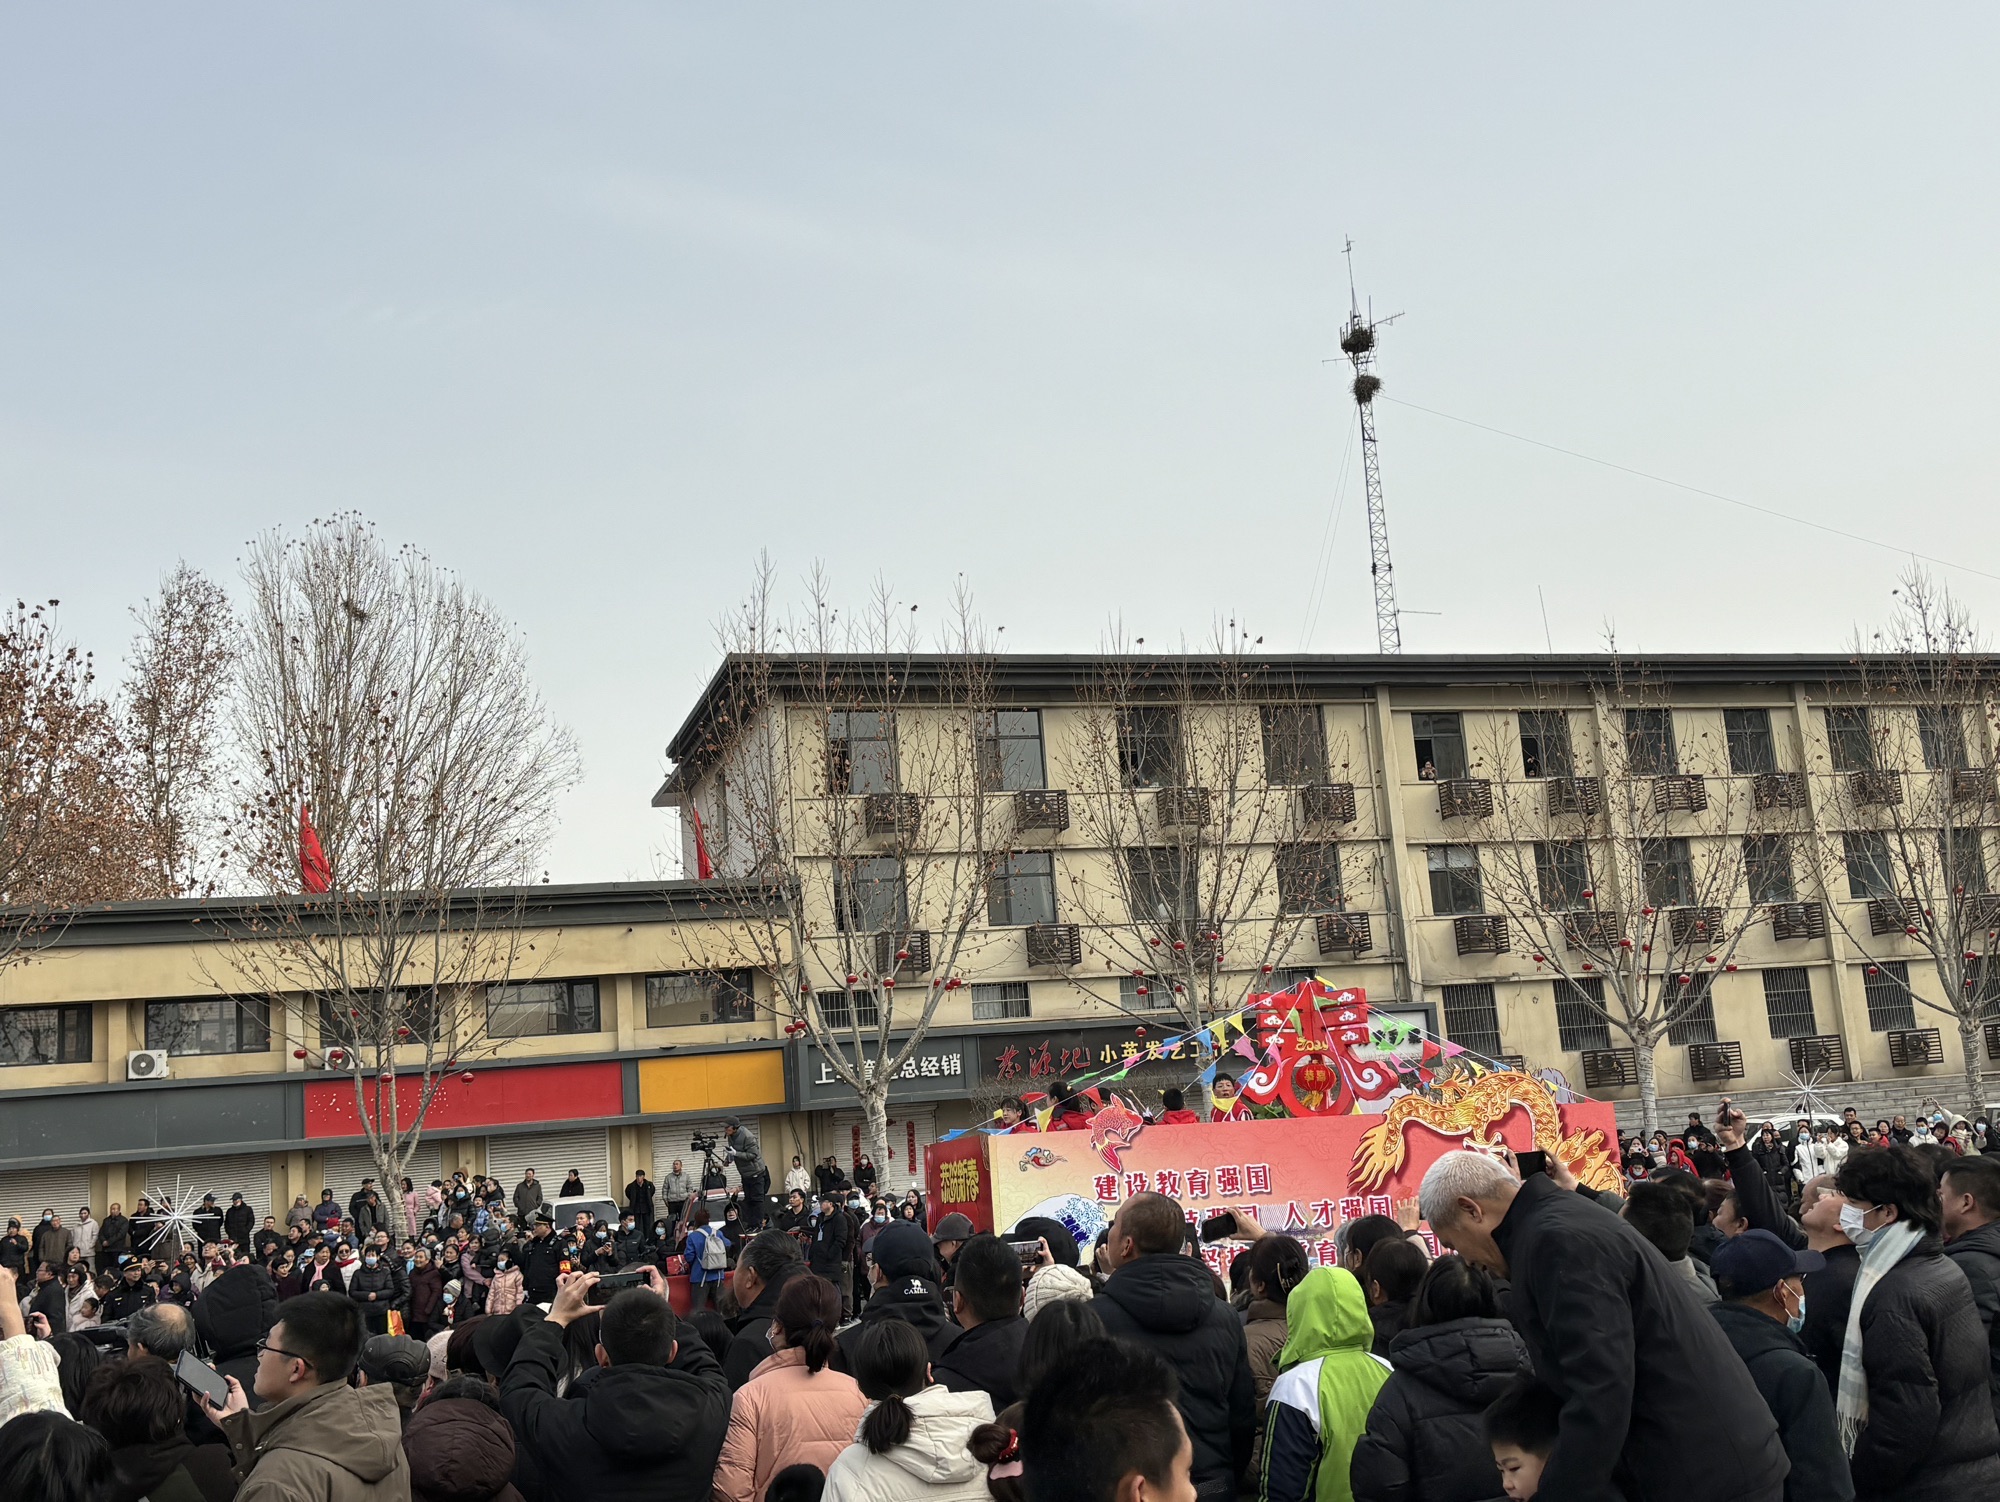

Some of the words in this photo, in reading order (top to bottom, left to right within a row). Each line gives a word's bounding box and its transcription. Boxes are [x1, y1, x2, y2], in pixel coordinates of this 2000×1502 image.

[1093, 1164, 1271, 1201] 建设教育强国
[1283, 1195, 1394, 1230] 人才强国
